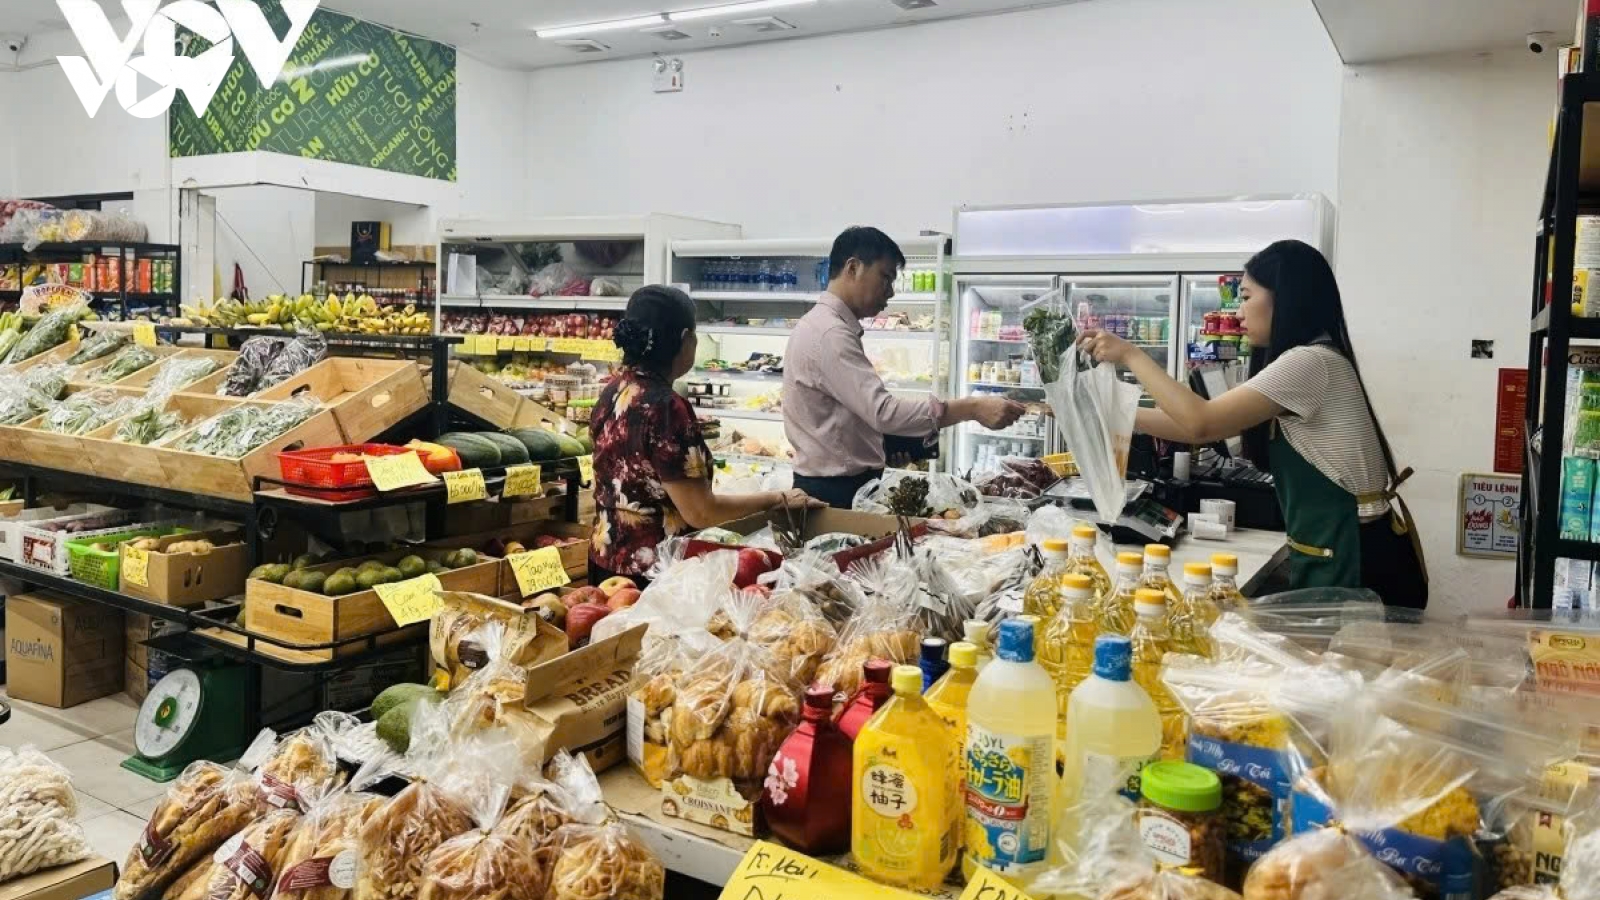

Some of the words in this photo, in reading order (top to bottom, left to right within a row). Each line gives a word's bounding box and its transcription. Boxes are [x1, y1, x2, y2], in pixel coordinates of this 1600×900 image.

[325, 71, 359, 106] HỮU
[359, 48, 380, 77] CƠ
[271, 94, 296, 124] CƠ
[378, 63, 412, 114] TƯƠI
[409, 114, 448, 168] SỐNG
[416, 93, 434, 115] AN
[370, 127, 409, 168] ORGANIC
[1473, 482, 1492, 492] TIÊU
[1495, 483, 1518, 494] LỆNH
[11, 638, 54, 660] AQUAFINA
[564, 670, 630, 706] BREAD
[870, 789, 907, 809] 柚子
